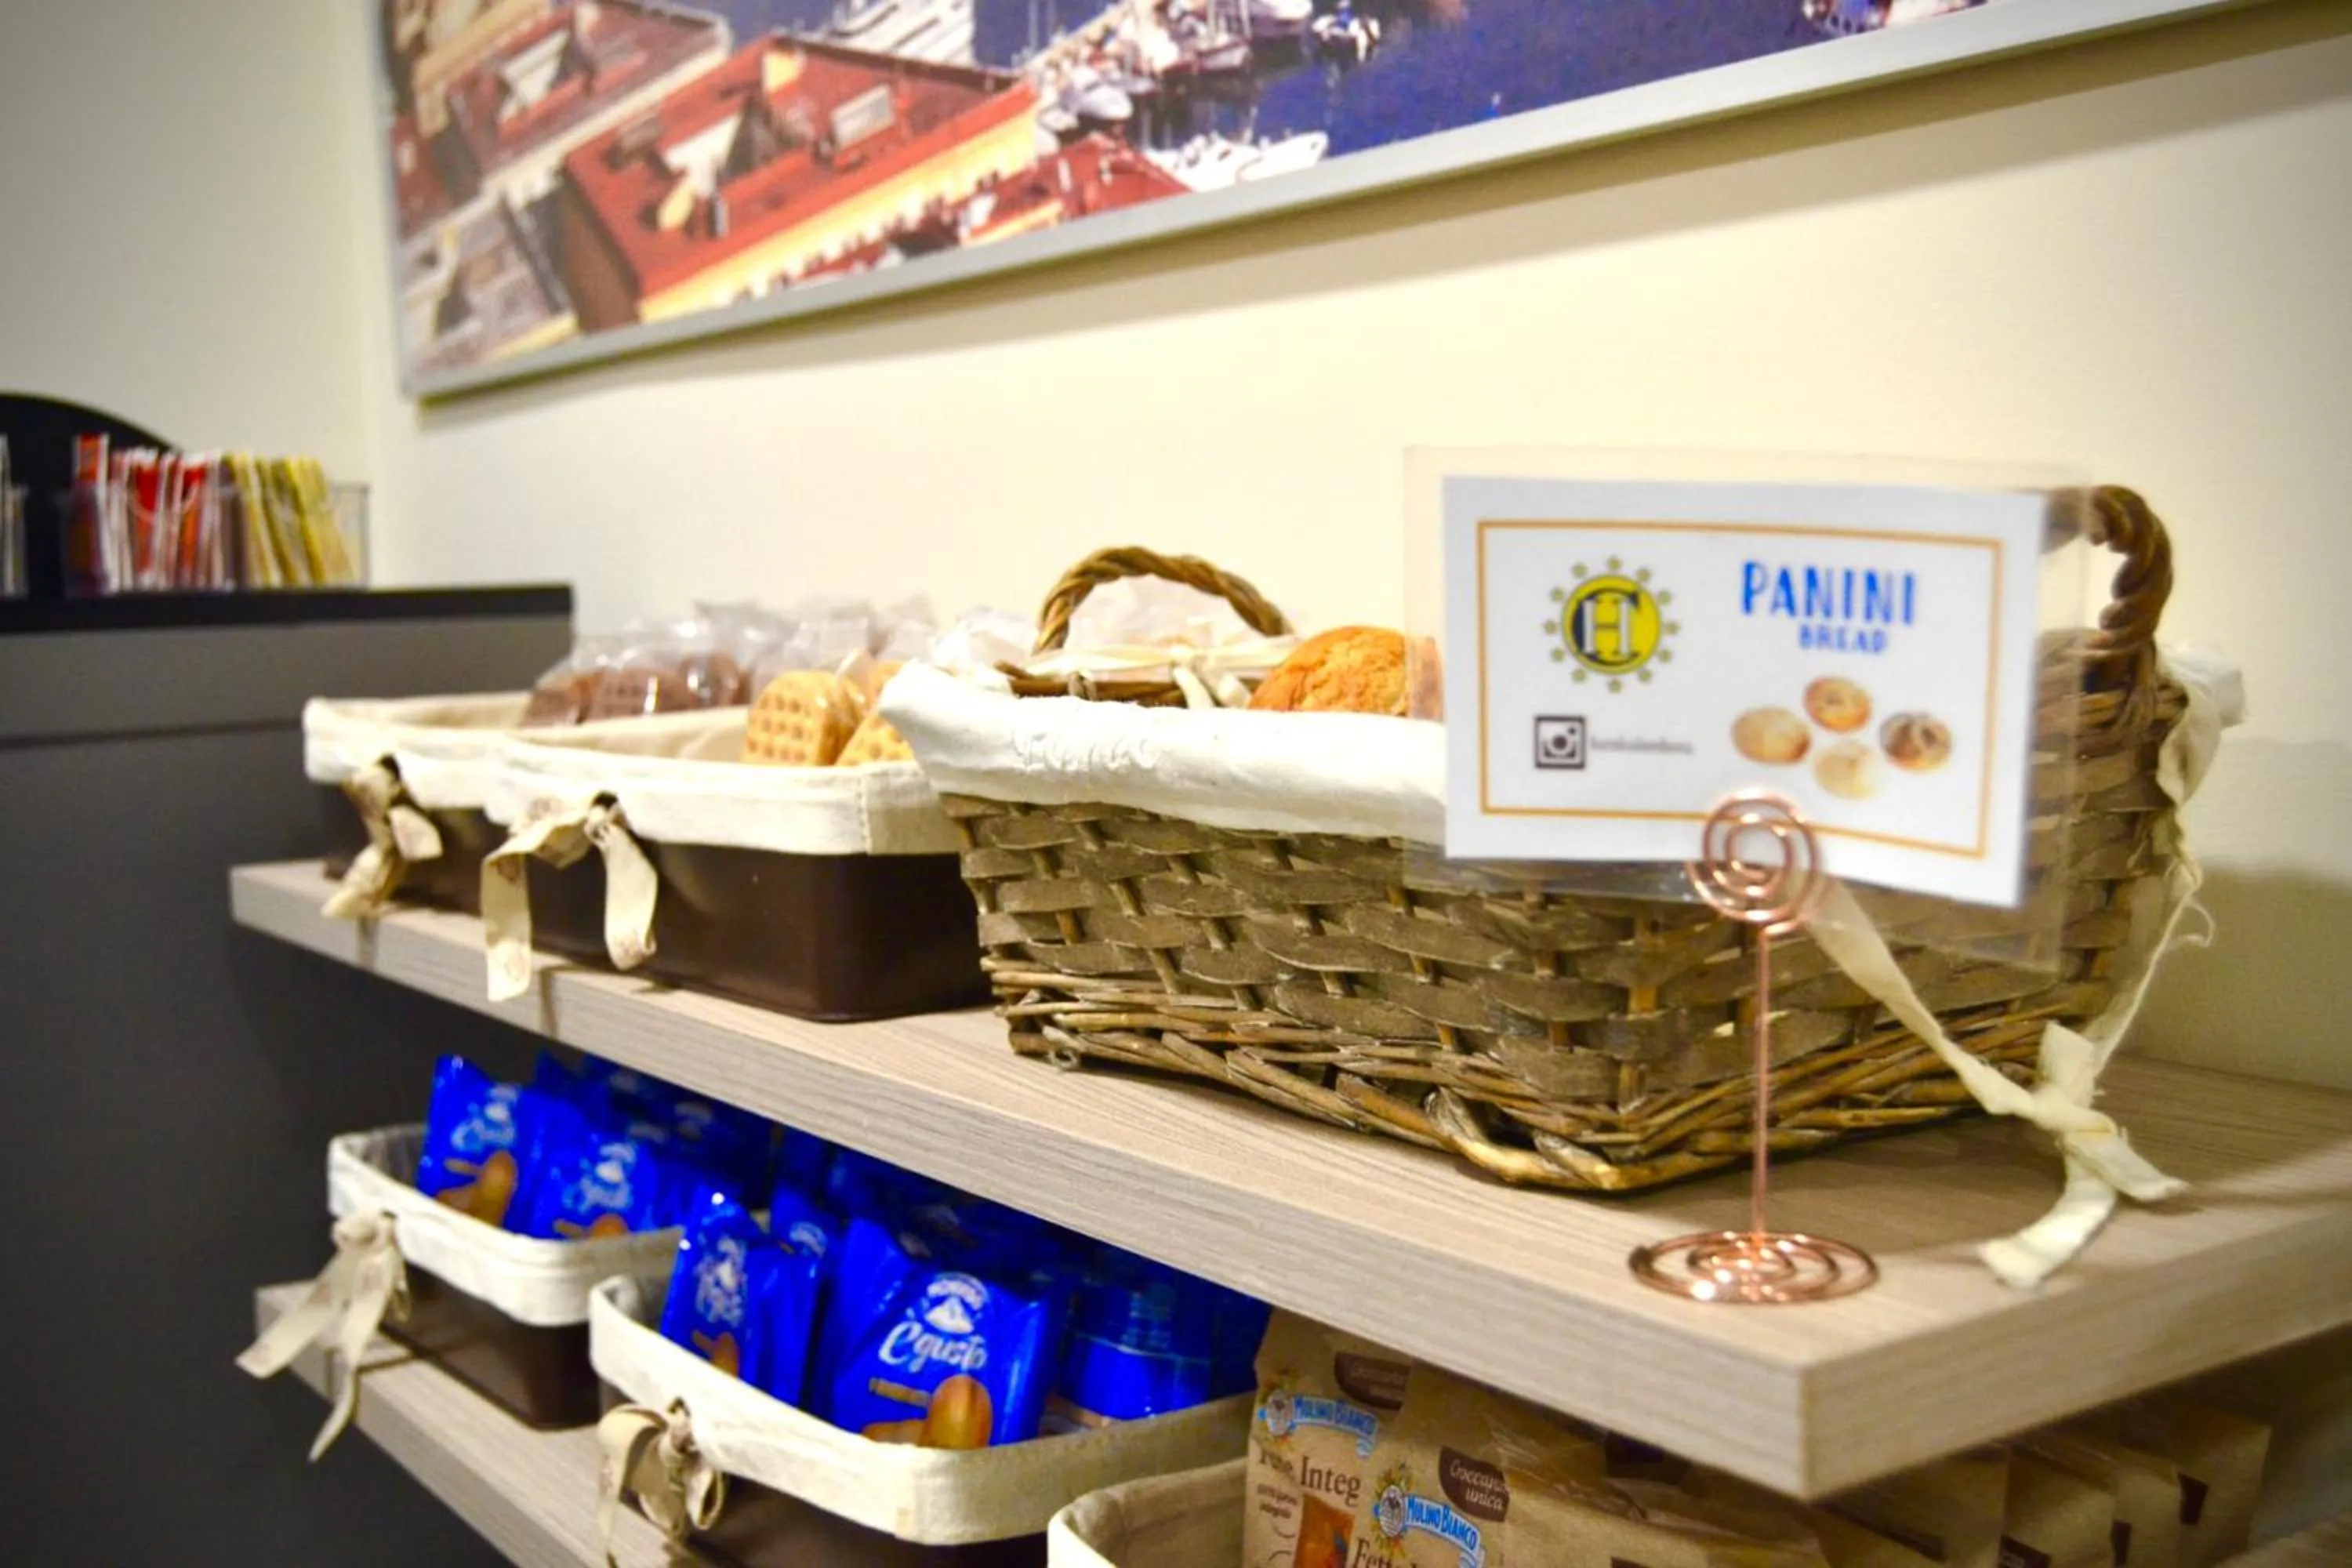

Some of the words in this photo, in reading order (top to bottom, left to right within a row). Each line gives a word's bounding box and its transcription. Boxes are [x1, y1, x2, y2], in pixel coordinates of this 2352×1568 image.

[1742, 560, 1916, 626] PANINI
[1799, 624, 1888, 653] BREAD
[1406, 1493, 1441, 1528] MULINO
[1441, 1504, 1479, 1552] BIANCO
